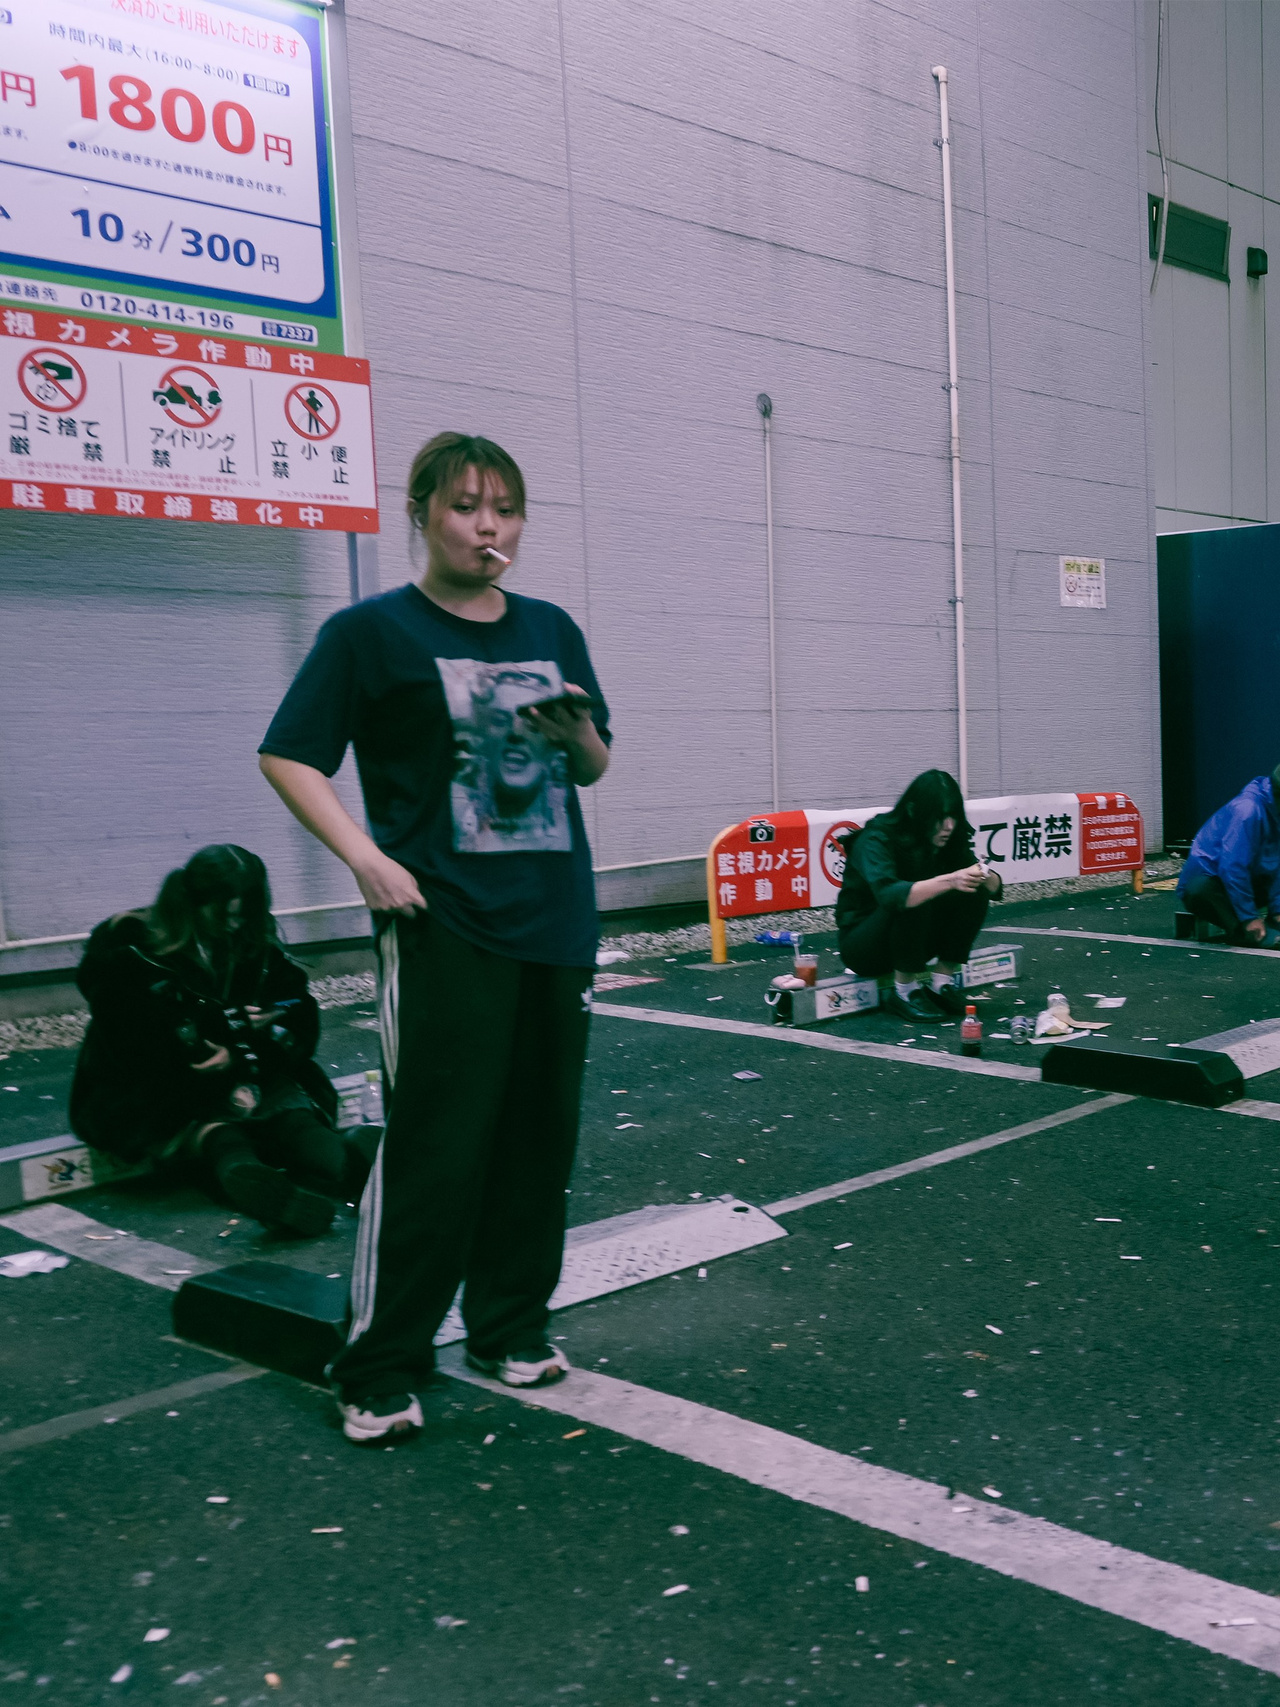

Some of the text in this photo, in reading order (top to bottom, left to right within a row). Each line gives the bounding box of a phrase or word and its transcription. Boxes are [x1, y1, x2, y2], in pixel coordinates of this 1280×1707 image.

[59, 64, 293, 166] 1800円
[71, 208, 280, 273] 10分/300円
[0, 281, 57, 302] 連絡先
[81, 292, 235, 330] 0120-414-196
[8, 410, 100, 438] ゴミ捨て
[150, 427, 236, 451] アイドリング
[152, 448, 236, 475] 禁止
[271, 439, 348, 465] 立小便
[272, 460, 349, 485] 禁止
[11, 483, 324, 527] 駐車取締強化中
[968, 813, 1073, 863] て厳禁
[717, 847, 808, 876] 監視カメラ
[719, 875, 808, 906] 作動中
